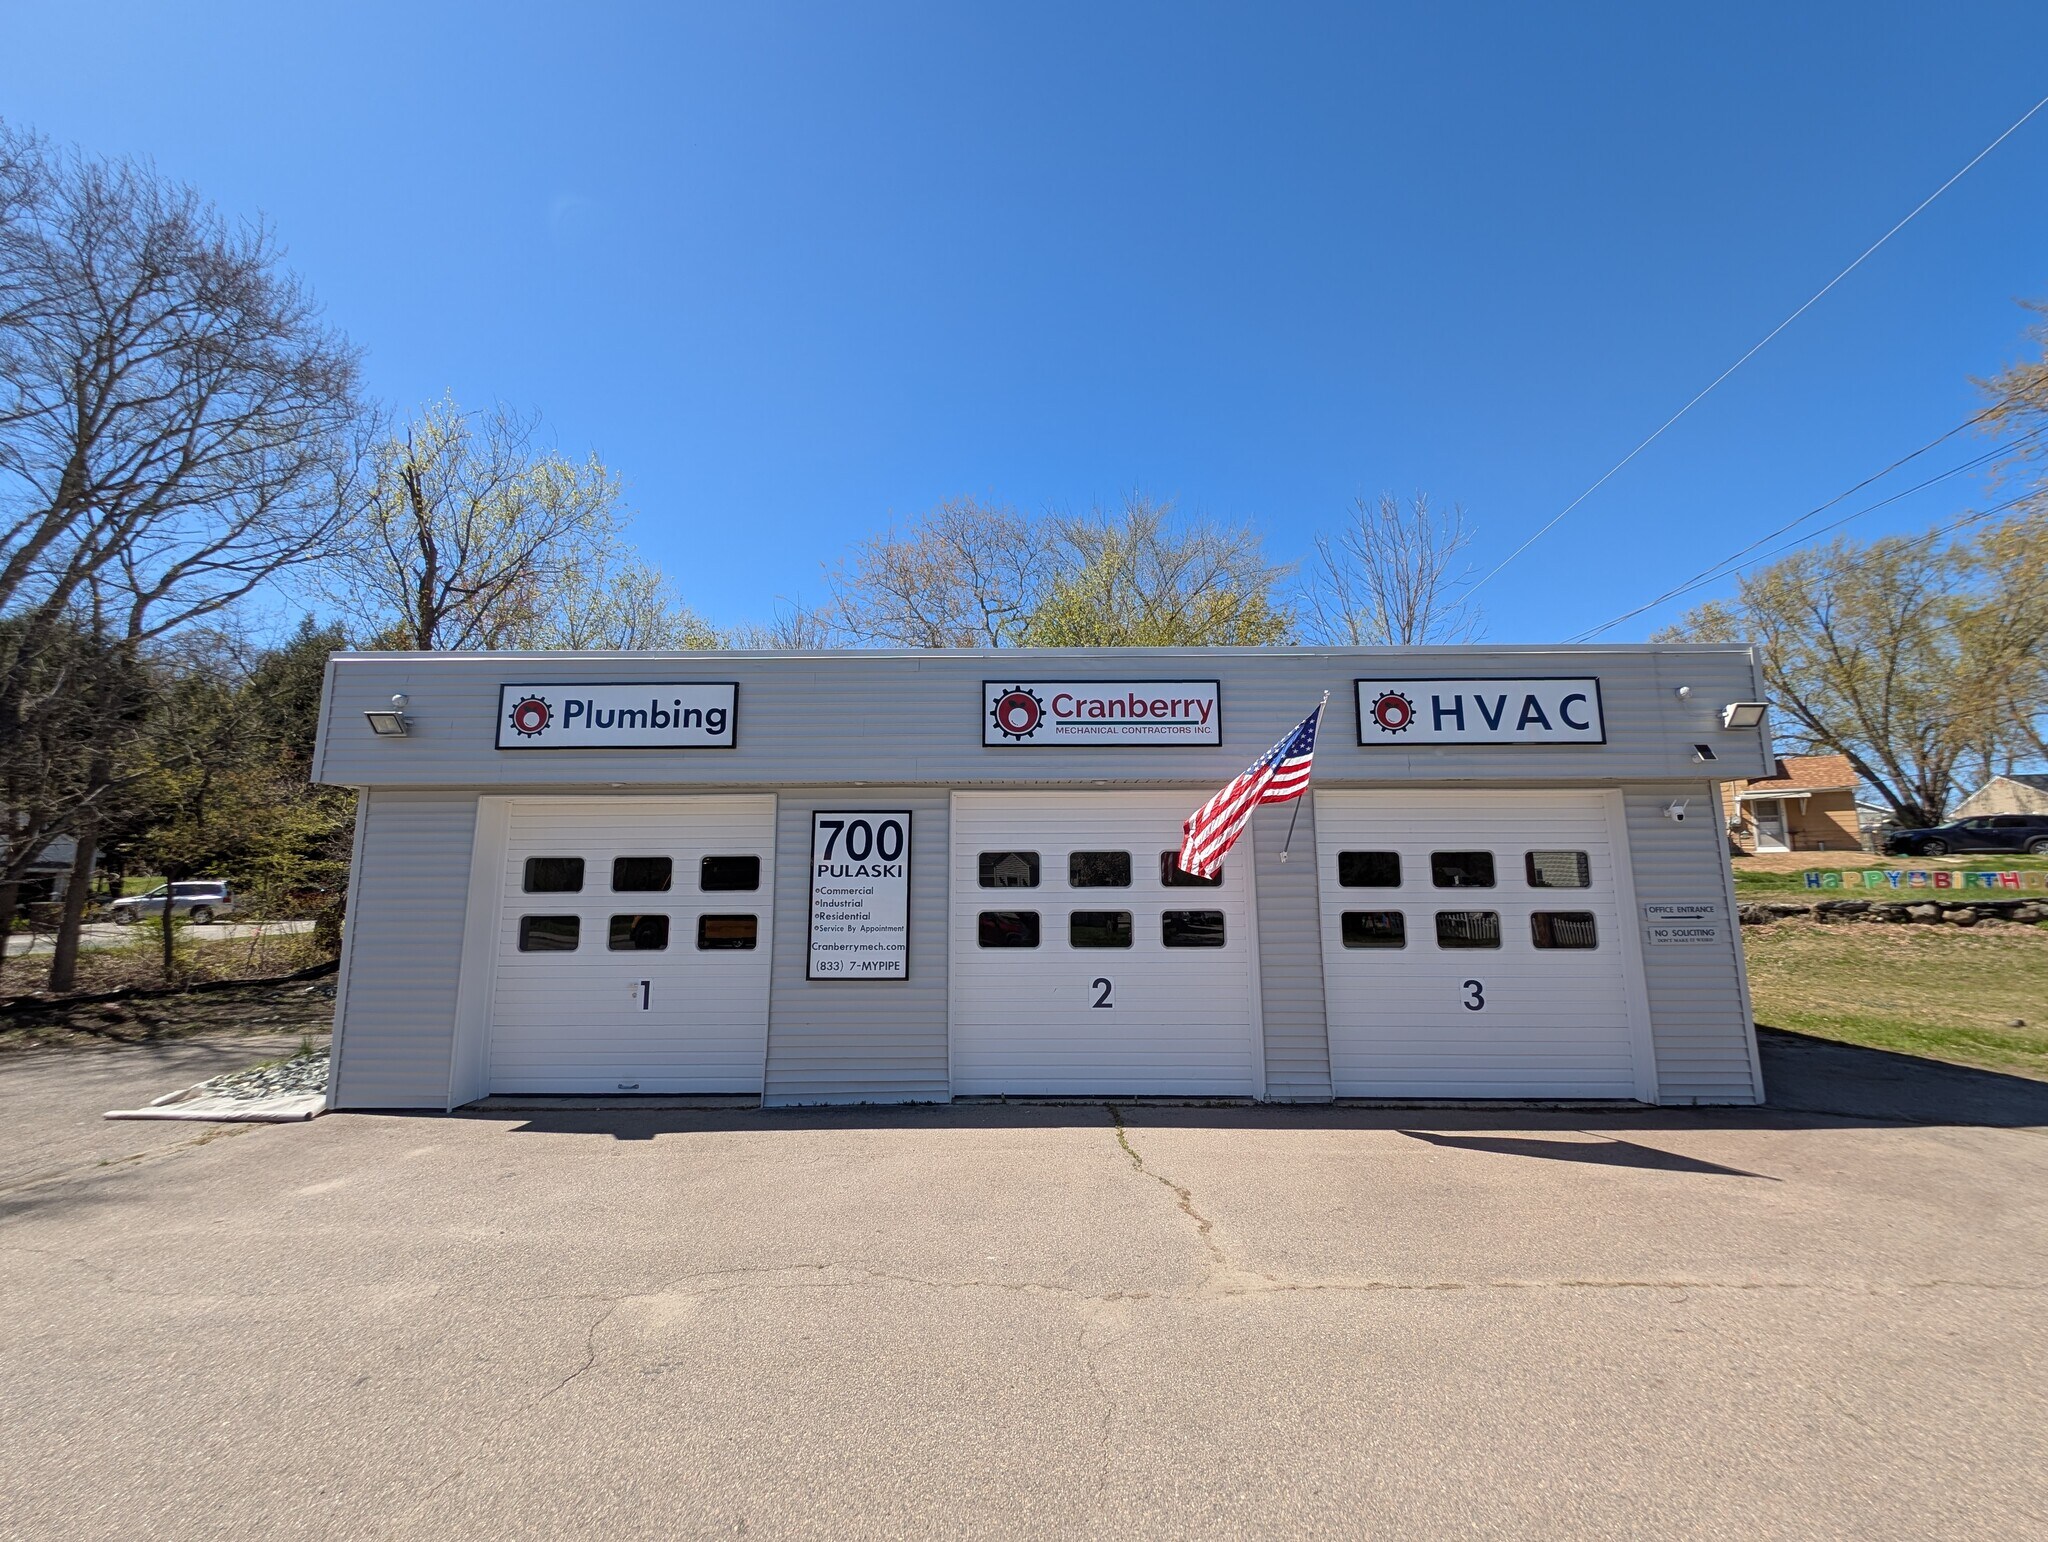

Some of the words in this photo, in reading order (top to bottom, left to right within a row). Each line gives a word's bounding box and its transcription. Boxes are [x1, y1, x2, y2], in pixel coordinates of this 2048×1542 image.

[1052, 693, 1214, 725] Cranberry
[1431, 694, 1590, 731] HVAC
[563, 699, 727, 735] Plumbing
[1055, 726, 1119, 734] MECHANICAL
[1121, 726, 1192, 734] CONTRACTORS
[1194, 726, 1213, 734] INC.
[819, 819, 904, 862] 700
[817, 864, 902, 878] PULASKI
[820, 886, 874, 895] Commercial
[820, 899, 863, 908] Industrial
[819, 912, 871, 921] Residential
[847, 925, 856, 934] By
[860, 925, 904, 933] Appointment
[1654, 929, 1668, 937] NO
[1671, 929, 1716, 937] SOLICITING
[811, 942, 906, 952] Cranberrymech.com
[816, 960, 844, 973] (833)
[849, 961, 900, 971] 7-MYPIPE
[640, 980, 651, 1010] 1
[1091, 977, 1113, 1008] 2
[1463, 979, 1485, 1011] 3
